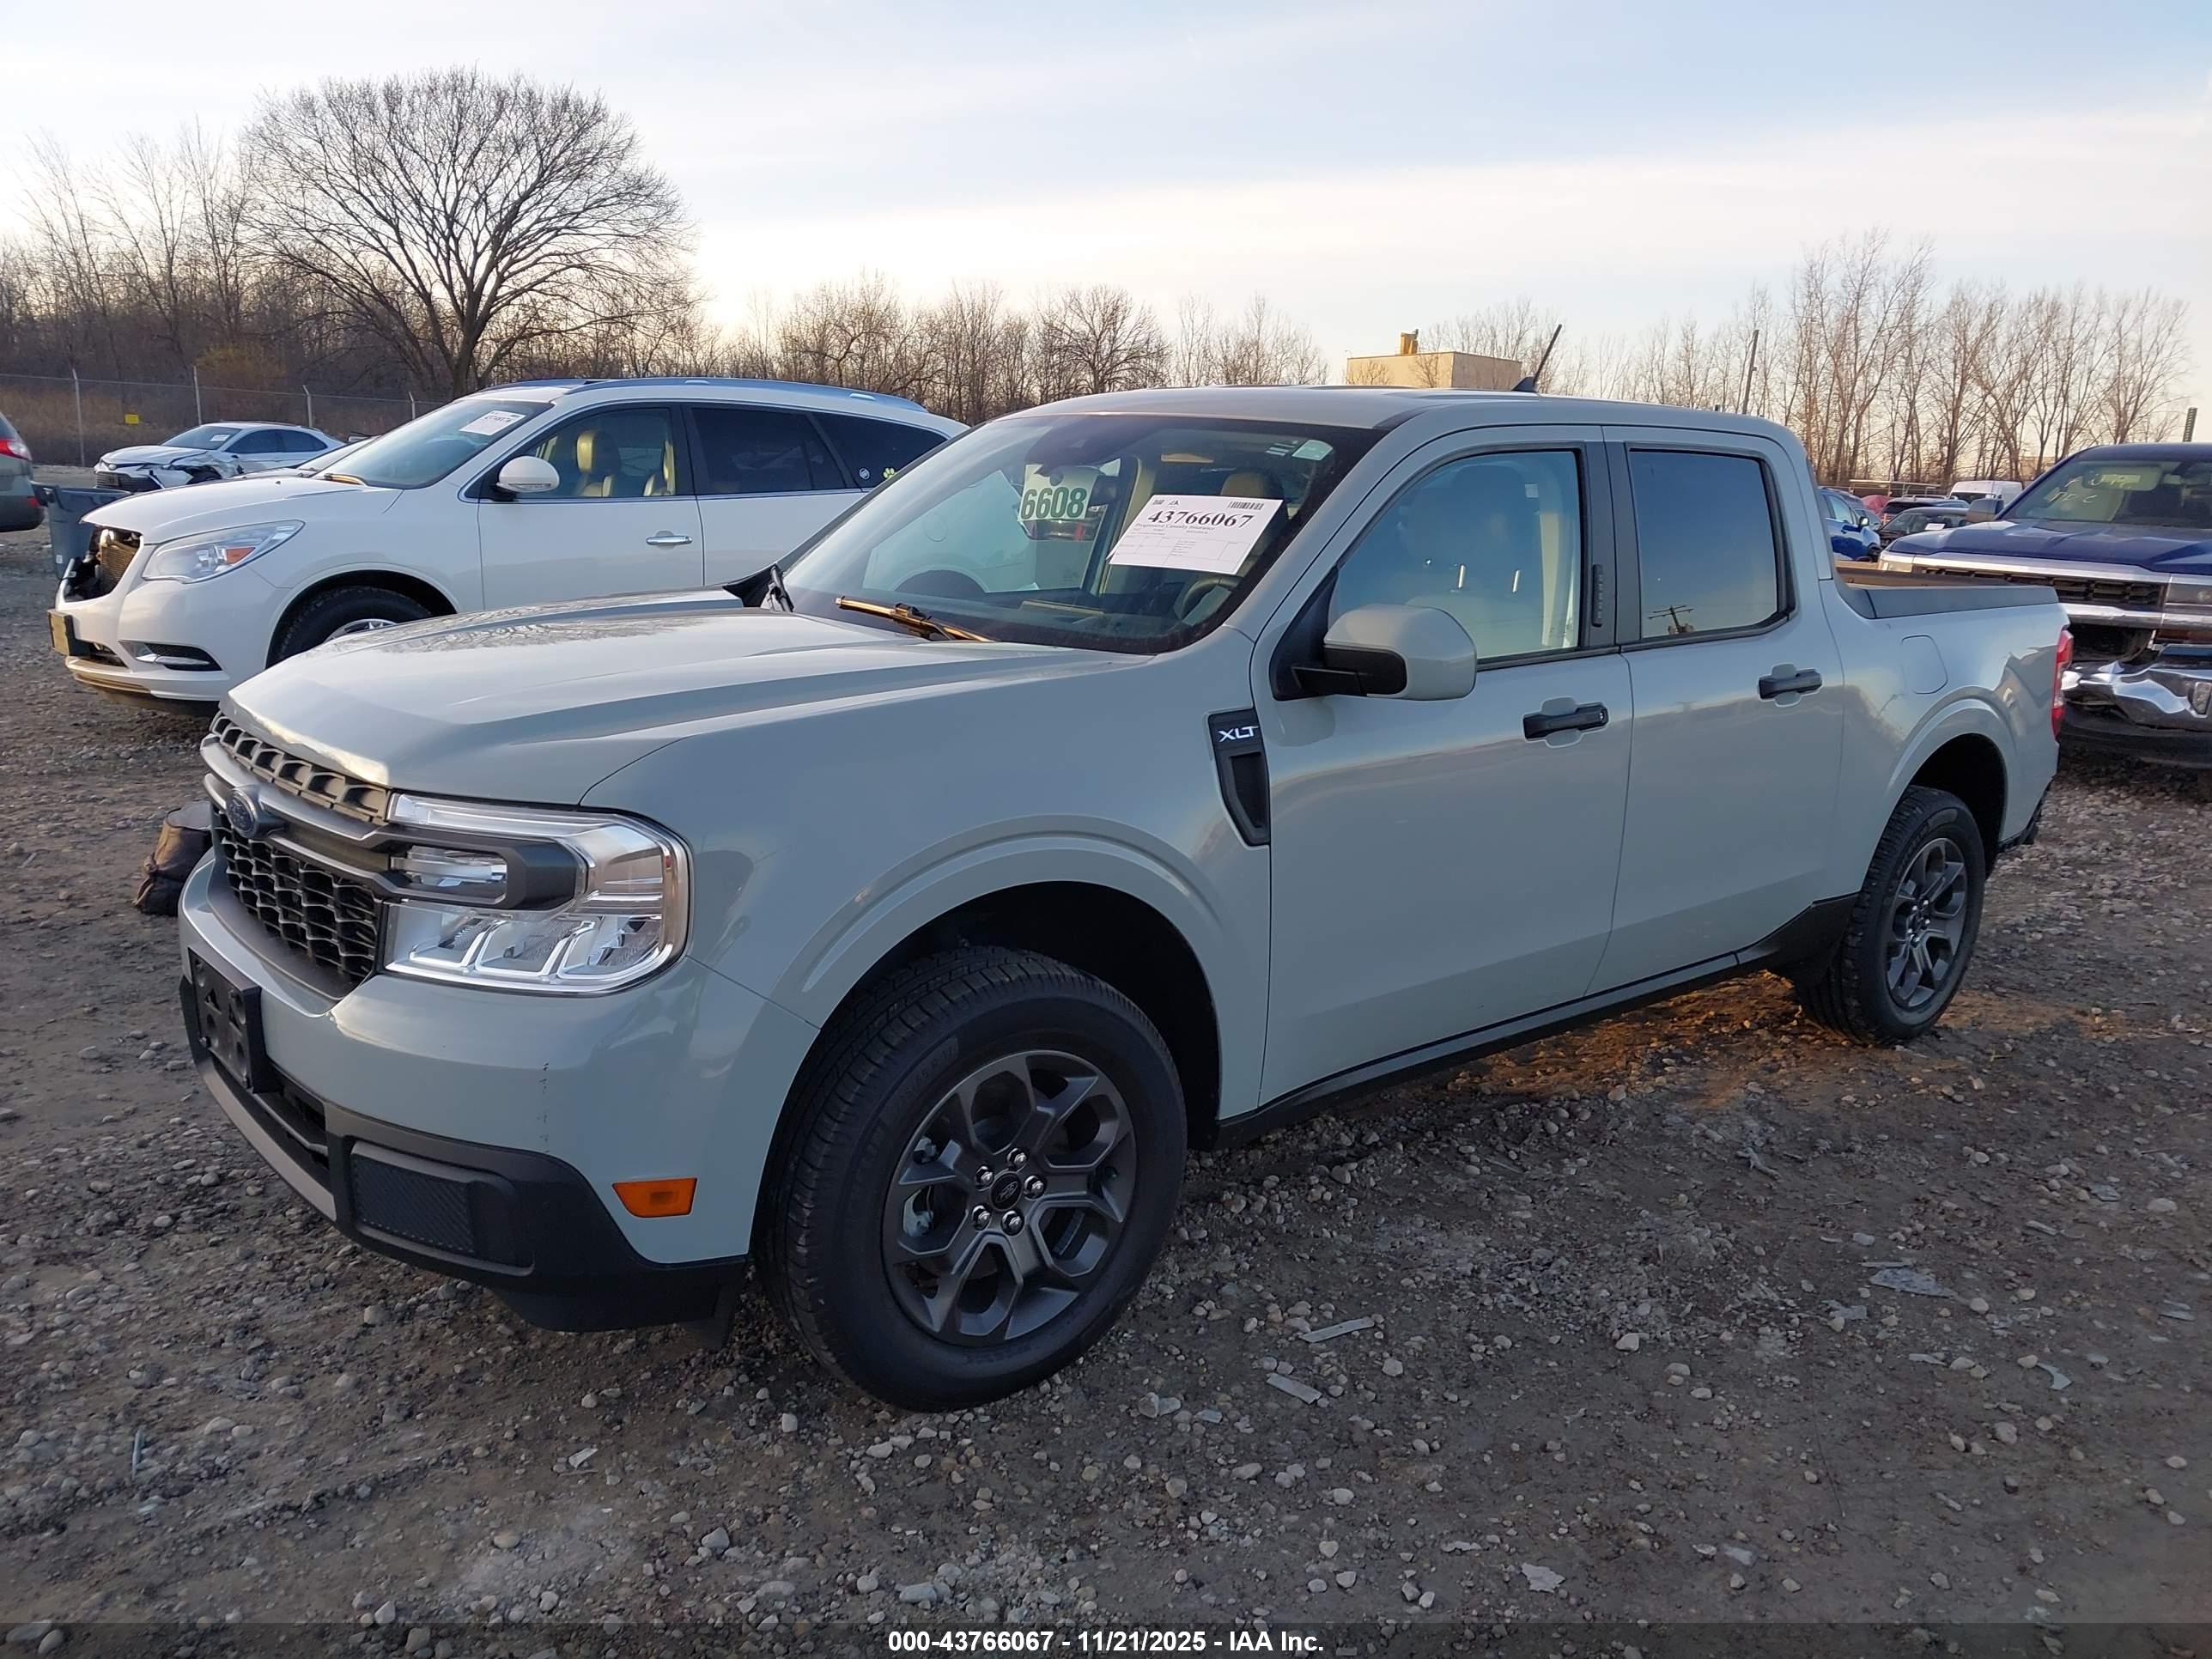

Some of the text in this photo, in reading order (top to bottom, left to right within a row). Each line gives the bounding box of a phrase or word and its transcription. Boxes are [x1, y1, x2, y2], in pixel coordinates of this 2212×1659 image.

[1020, 486, 1088, 520] 6608
[1147, 510, 1255, 528] 43766067
[1218, 725, 1259, 743] XLT
